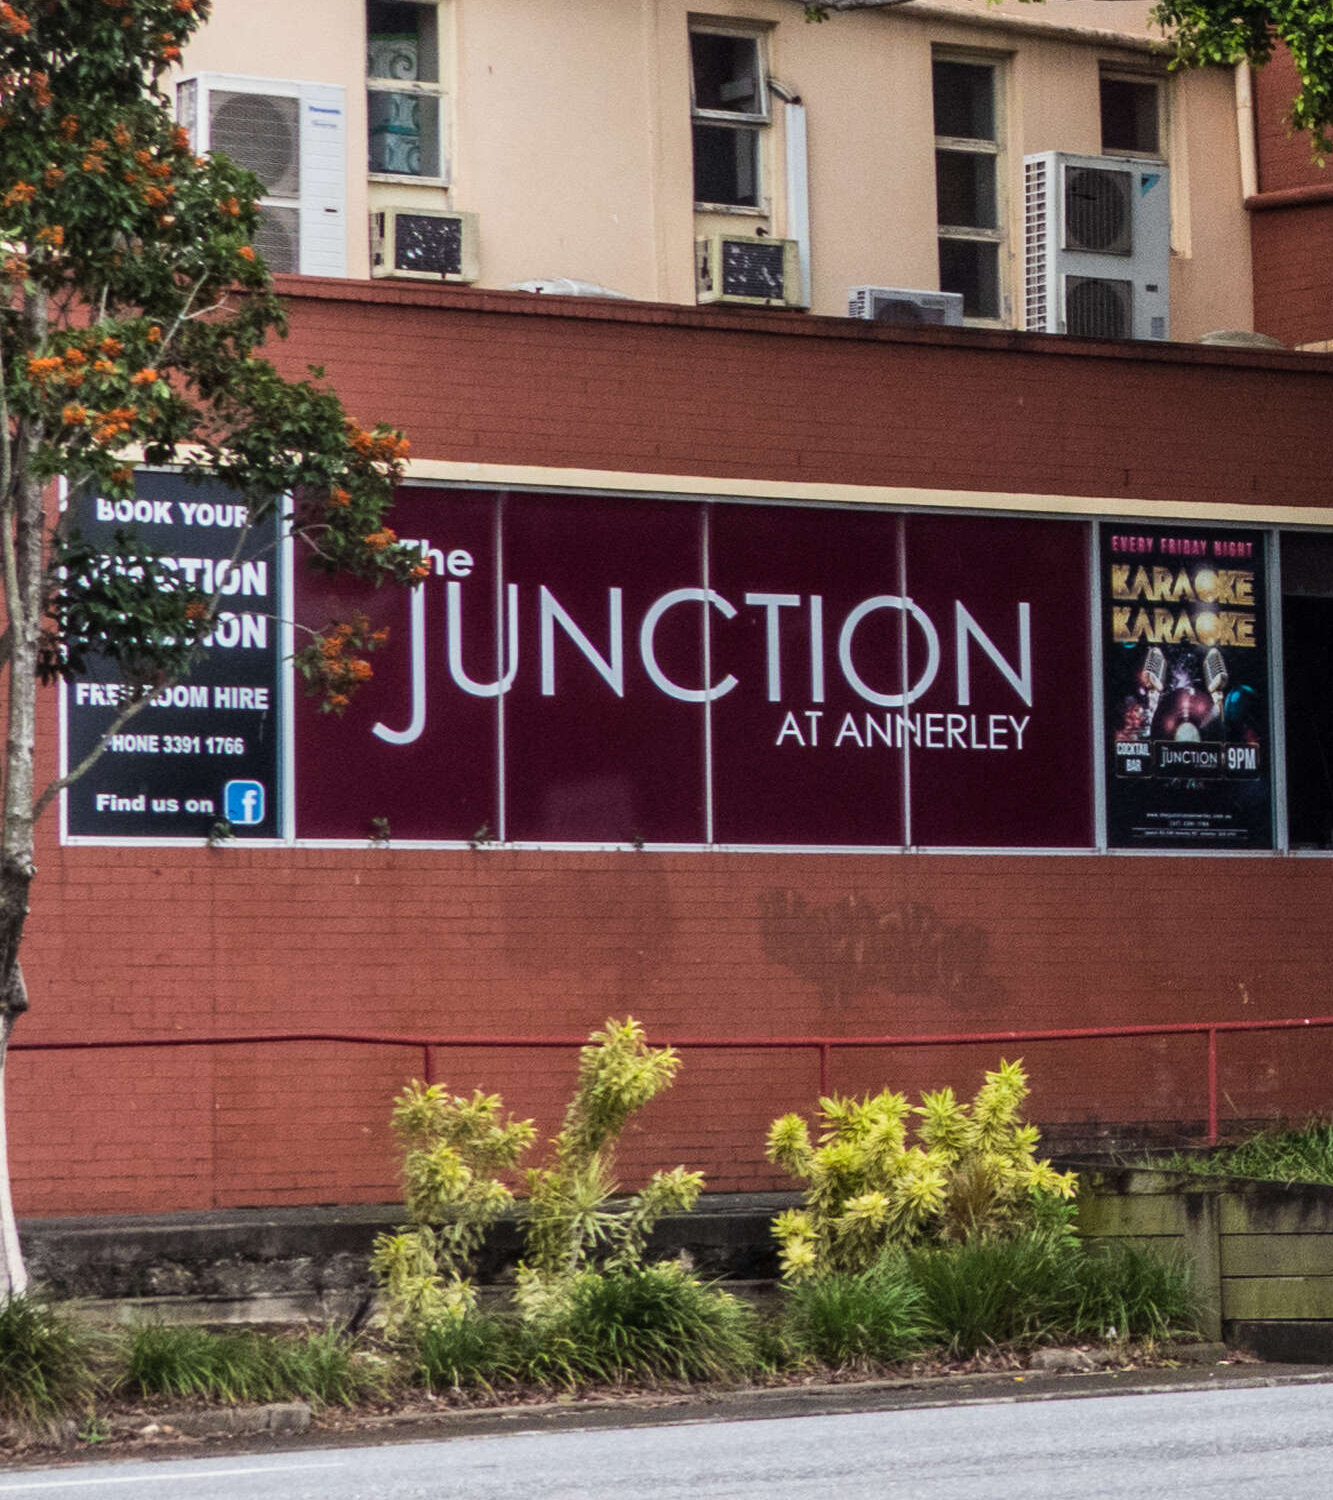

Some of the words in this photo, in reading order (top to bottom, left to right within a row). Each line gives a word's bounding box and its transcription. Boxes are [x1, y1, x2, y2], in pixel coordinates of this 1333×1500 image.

[96, 498, 173, 524] BOOK
[178, 502, 251, 527] YOUR
[1112, 536, 1153, 553] EVERY
[1161, 538, 1207, 556] FRIDAY
[1214, 541, 1253, 557] NIGHT
[1112, 564, 1255, 606] KARAOKE
[1113, 606, 1256, 647] KARAOKE
[372, 581, 1032, 744] JUNCTION
[214, 687, 269, 710] HIRE
[776, 712, 823, 747] AT
[835, 712, 1031, 751] ANNERLEY
[101, 735, 158, 752] HONE
[163, 736, 200, 753] 3391
[205, 738, 244, 754] 1766
[1116, 743, 1150, 756] COCKTAIL
[1126, 758, 1142, 772] BAR
[1159, 749, 1218, 768] JUNCTION
[1228, 747, 1256, 770] 9PM
[96, 794, 145, 812] Find
[152, 800, 179, 813] us
[185, 800, 214, 814] on
